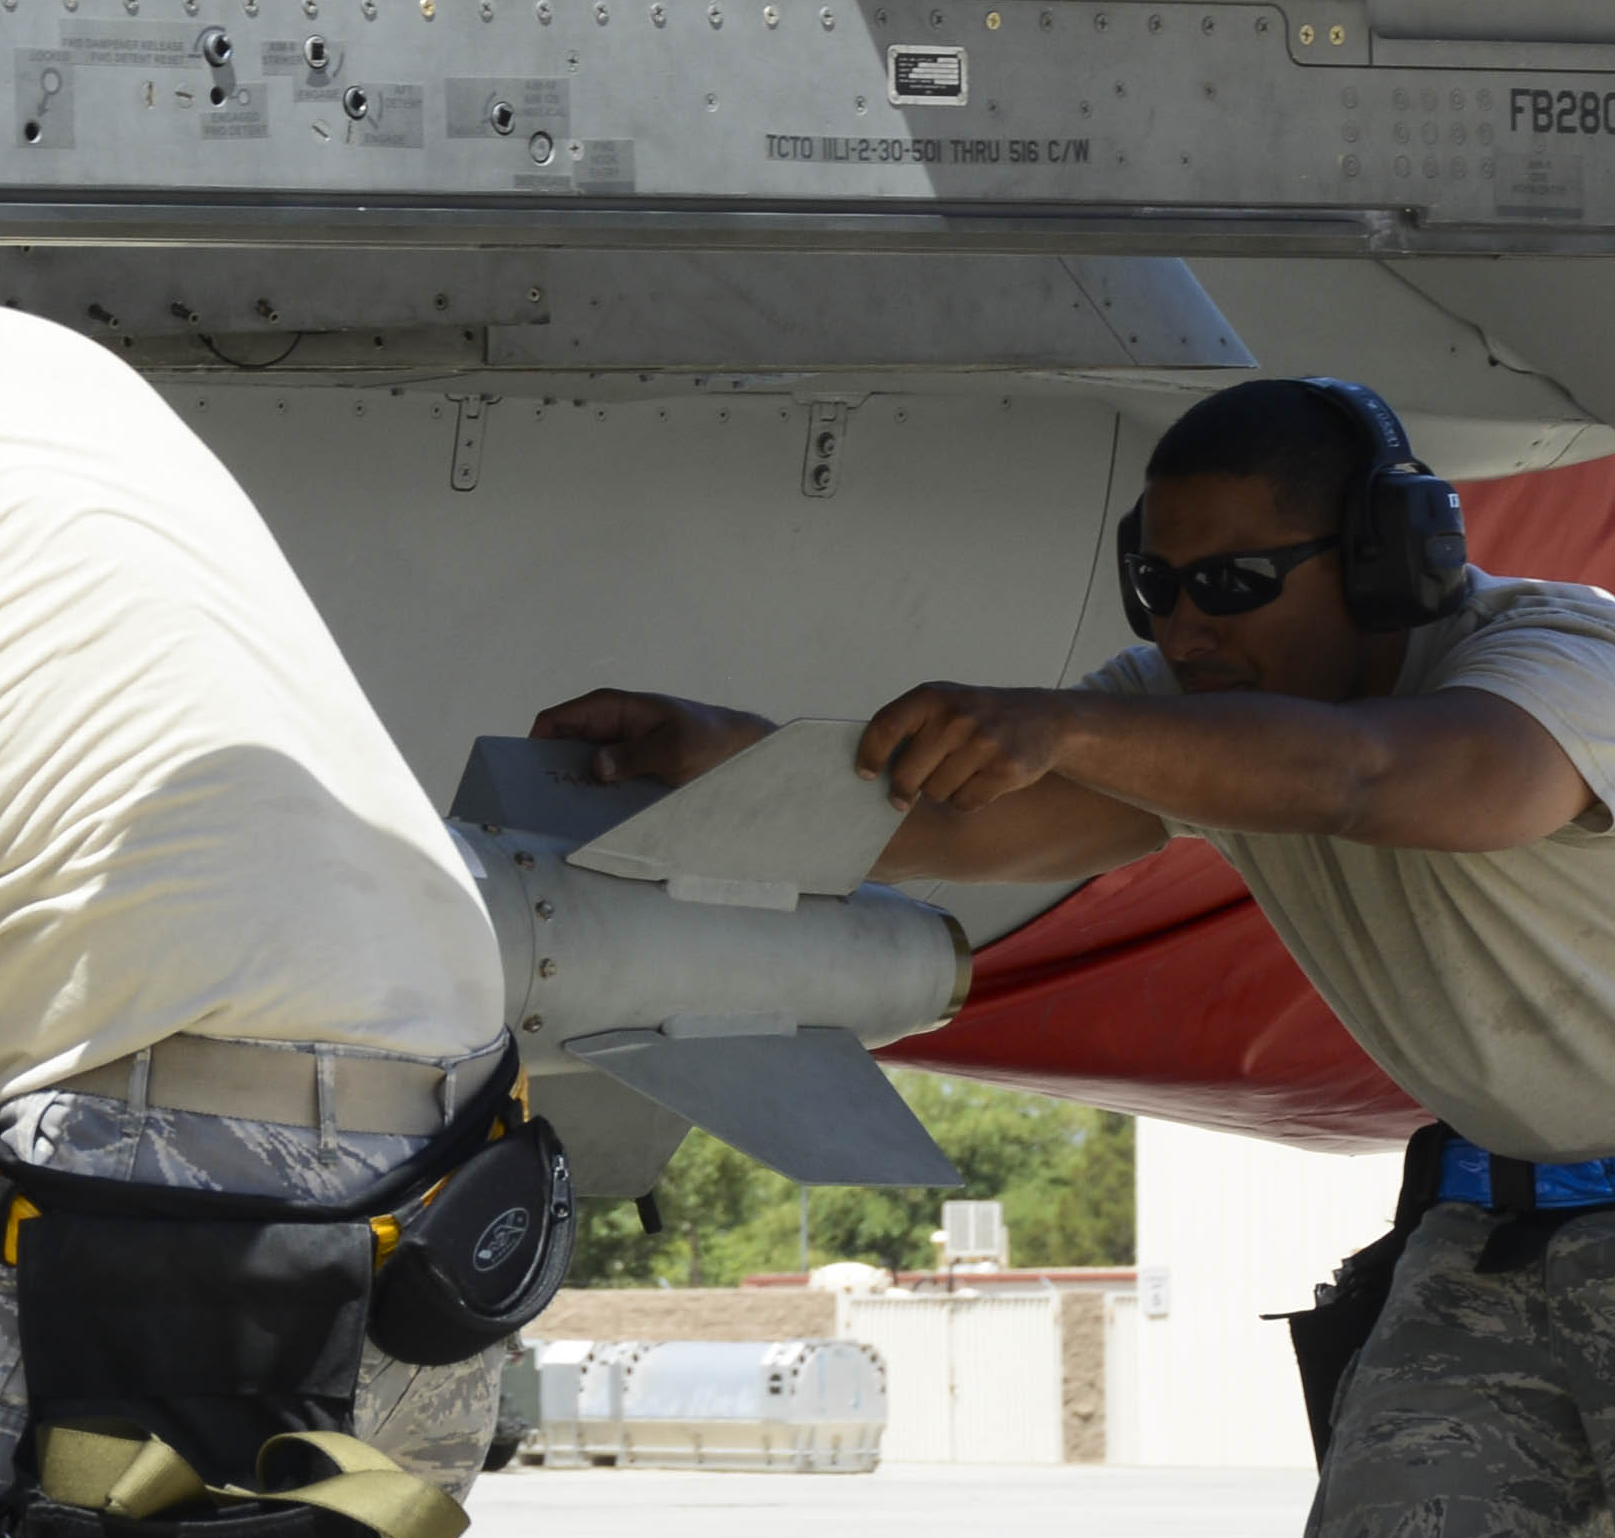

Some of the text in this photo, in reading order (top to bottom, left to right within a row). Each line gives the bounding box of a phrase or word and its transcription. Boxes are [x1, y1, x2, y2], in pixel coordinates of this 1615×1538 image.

[766, 134, 813, 159] TCTO
[950, 139, 1000, 163] THRU
[1009, 140, 1039, 163] 516
[1046, 139, 1089, 163] C/W
